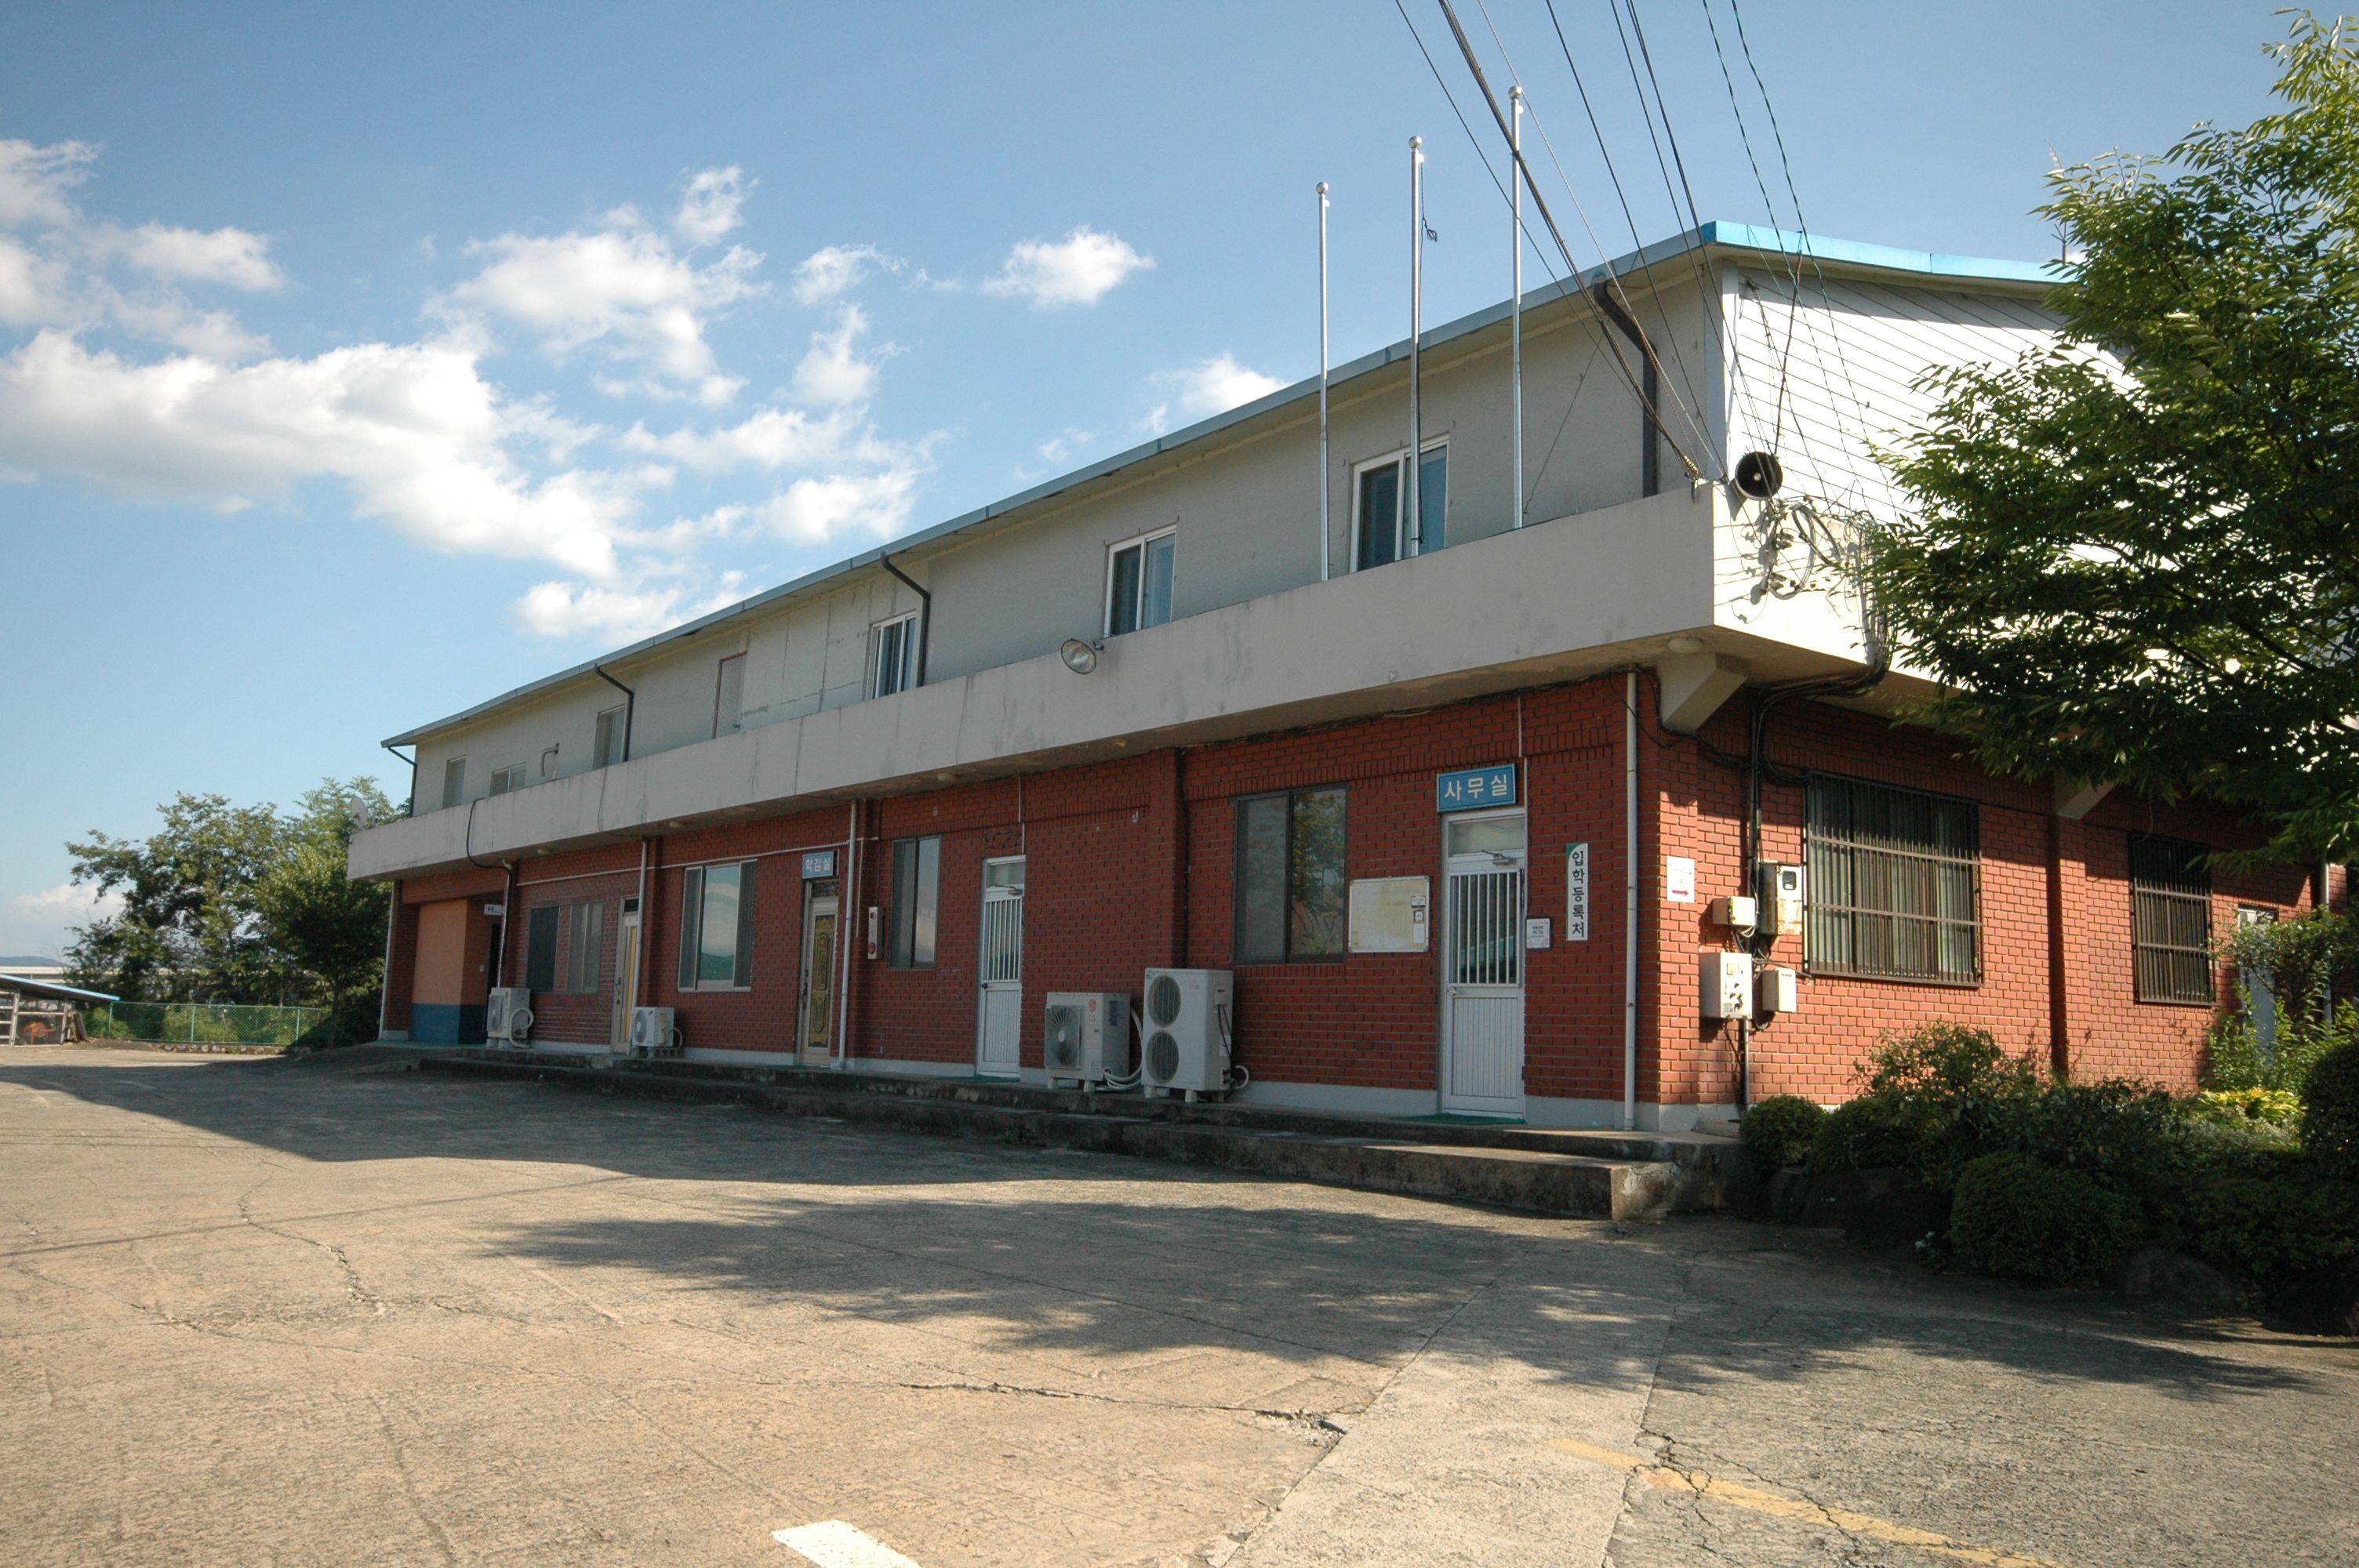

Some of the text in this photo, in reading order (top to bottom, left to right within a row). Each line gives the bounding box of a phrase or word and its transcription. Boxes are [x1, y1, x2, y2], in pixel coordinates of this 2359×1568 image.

[1445, 773, 1507, 801] 사무실
[805, 857, 831, 872] 학감실
[1572, 850, 1585, 938] 입학등록처
[1089, 1014, 1096, 1022] LG
